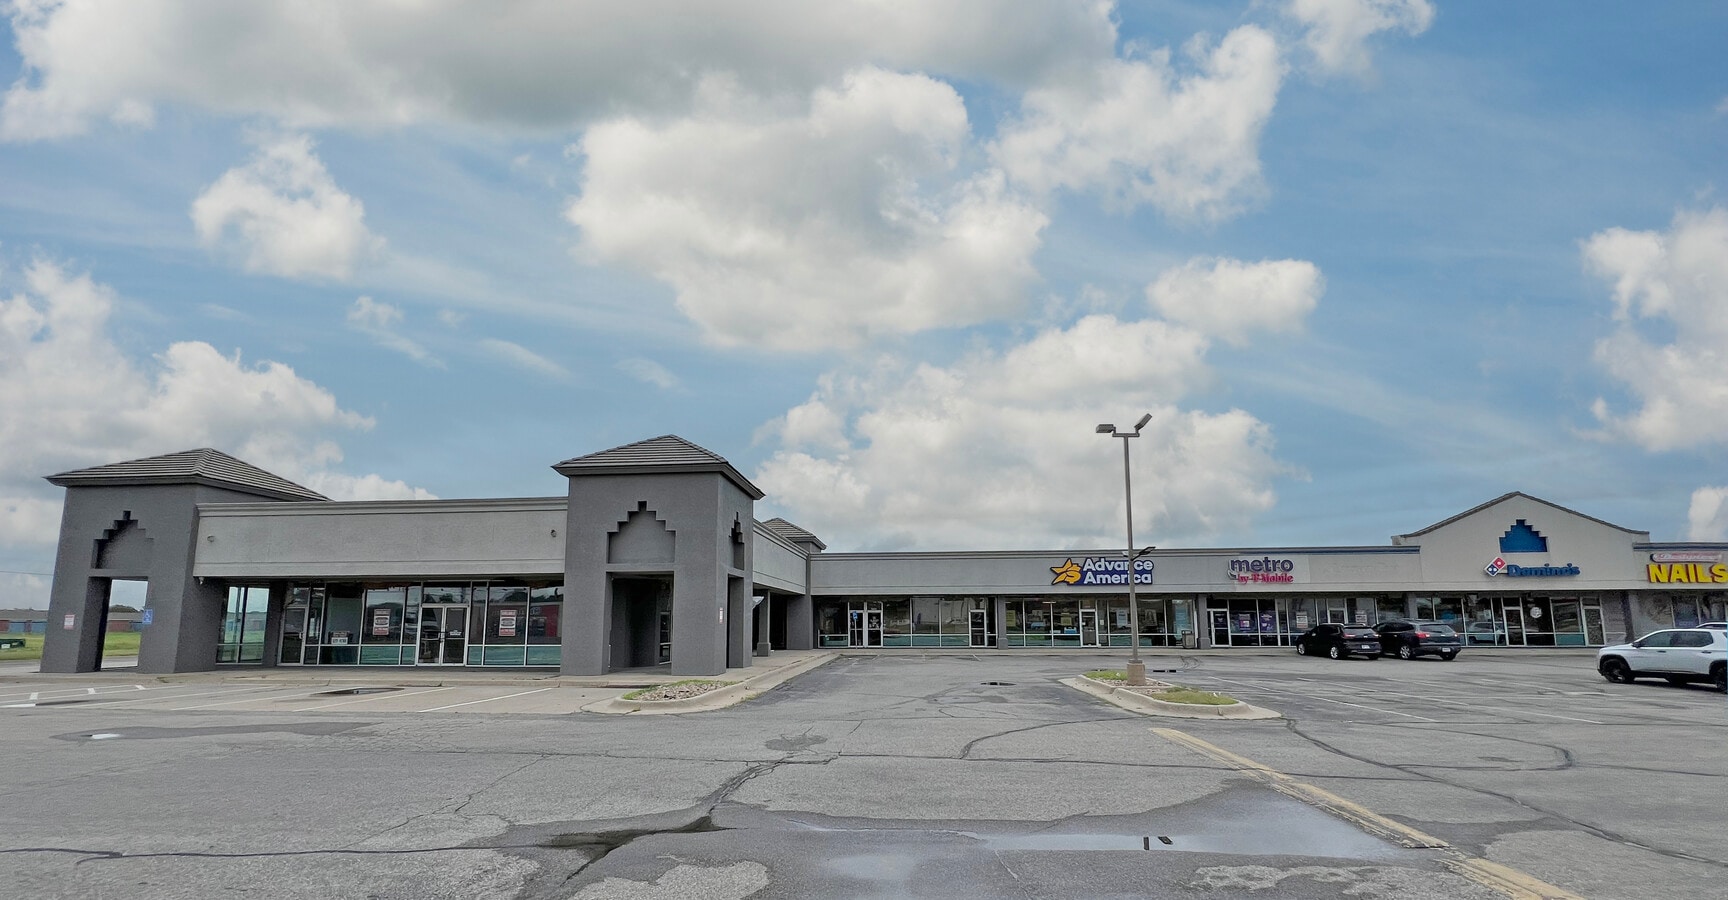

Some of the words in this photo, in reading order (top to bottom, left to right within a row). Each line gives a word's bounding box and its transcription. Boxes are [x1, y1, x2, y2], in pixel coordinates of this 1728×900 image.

[1230, 556, 1294, 571] metro
[1507, 563, 1581, 577] Domino's
[1237, 573, 1250, 584] by
[1252, 573, 1294, 583] T-Mobile
[1648, 563, 1728, 583] NAILS
